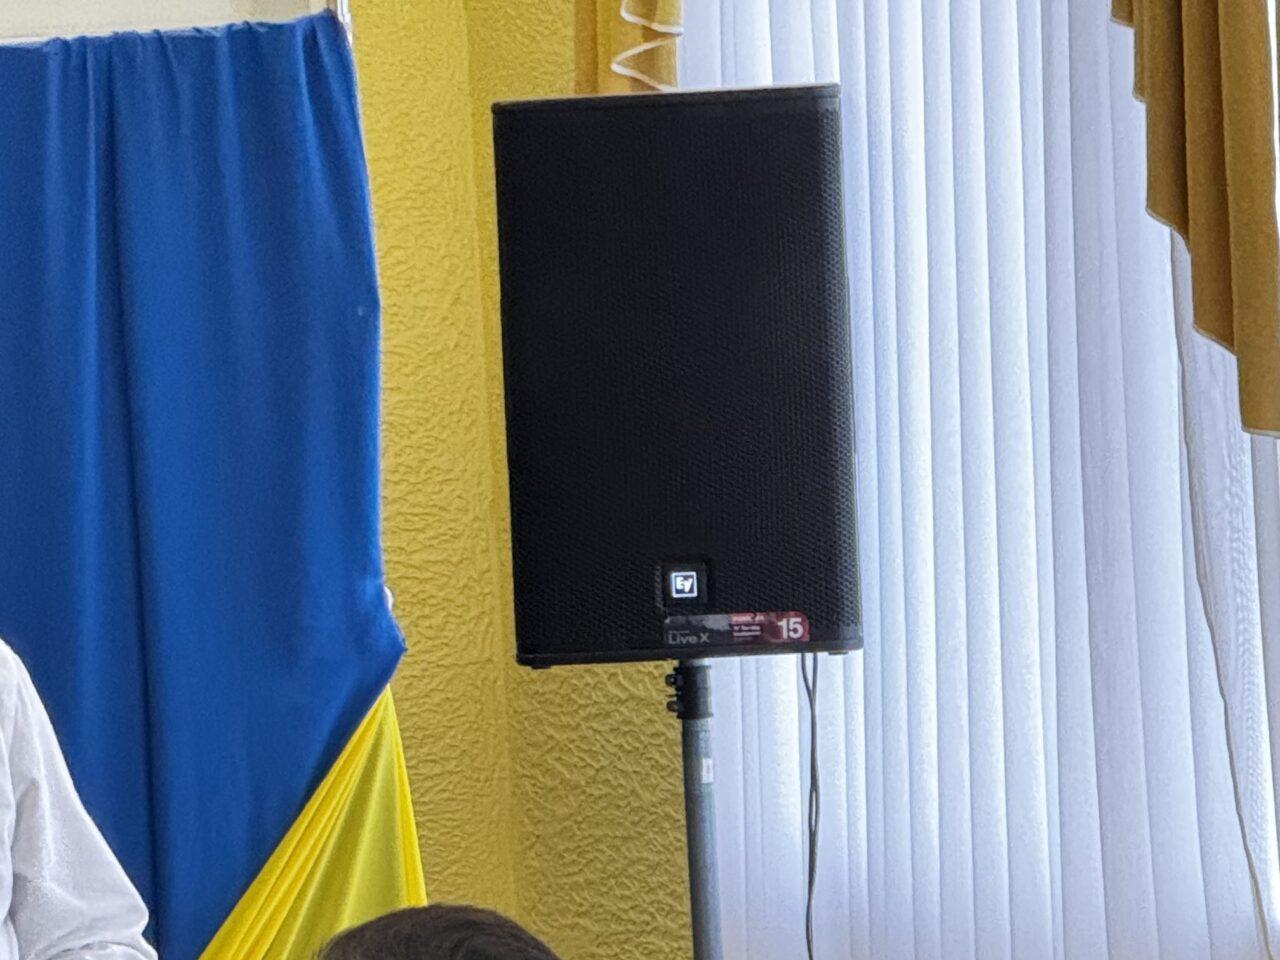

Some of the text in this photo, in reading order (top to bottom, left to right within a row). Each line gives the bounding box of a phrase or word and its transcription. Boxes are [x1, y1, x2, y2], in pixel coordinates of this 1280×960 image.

[668, 631, 710, 644] Live X
[777, 617, 804, 640] 15
